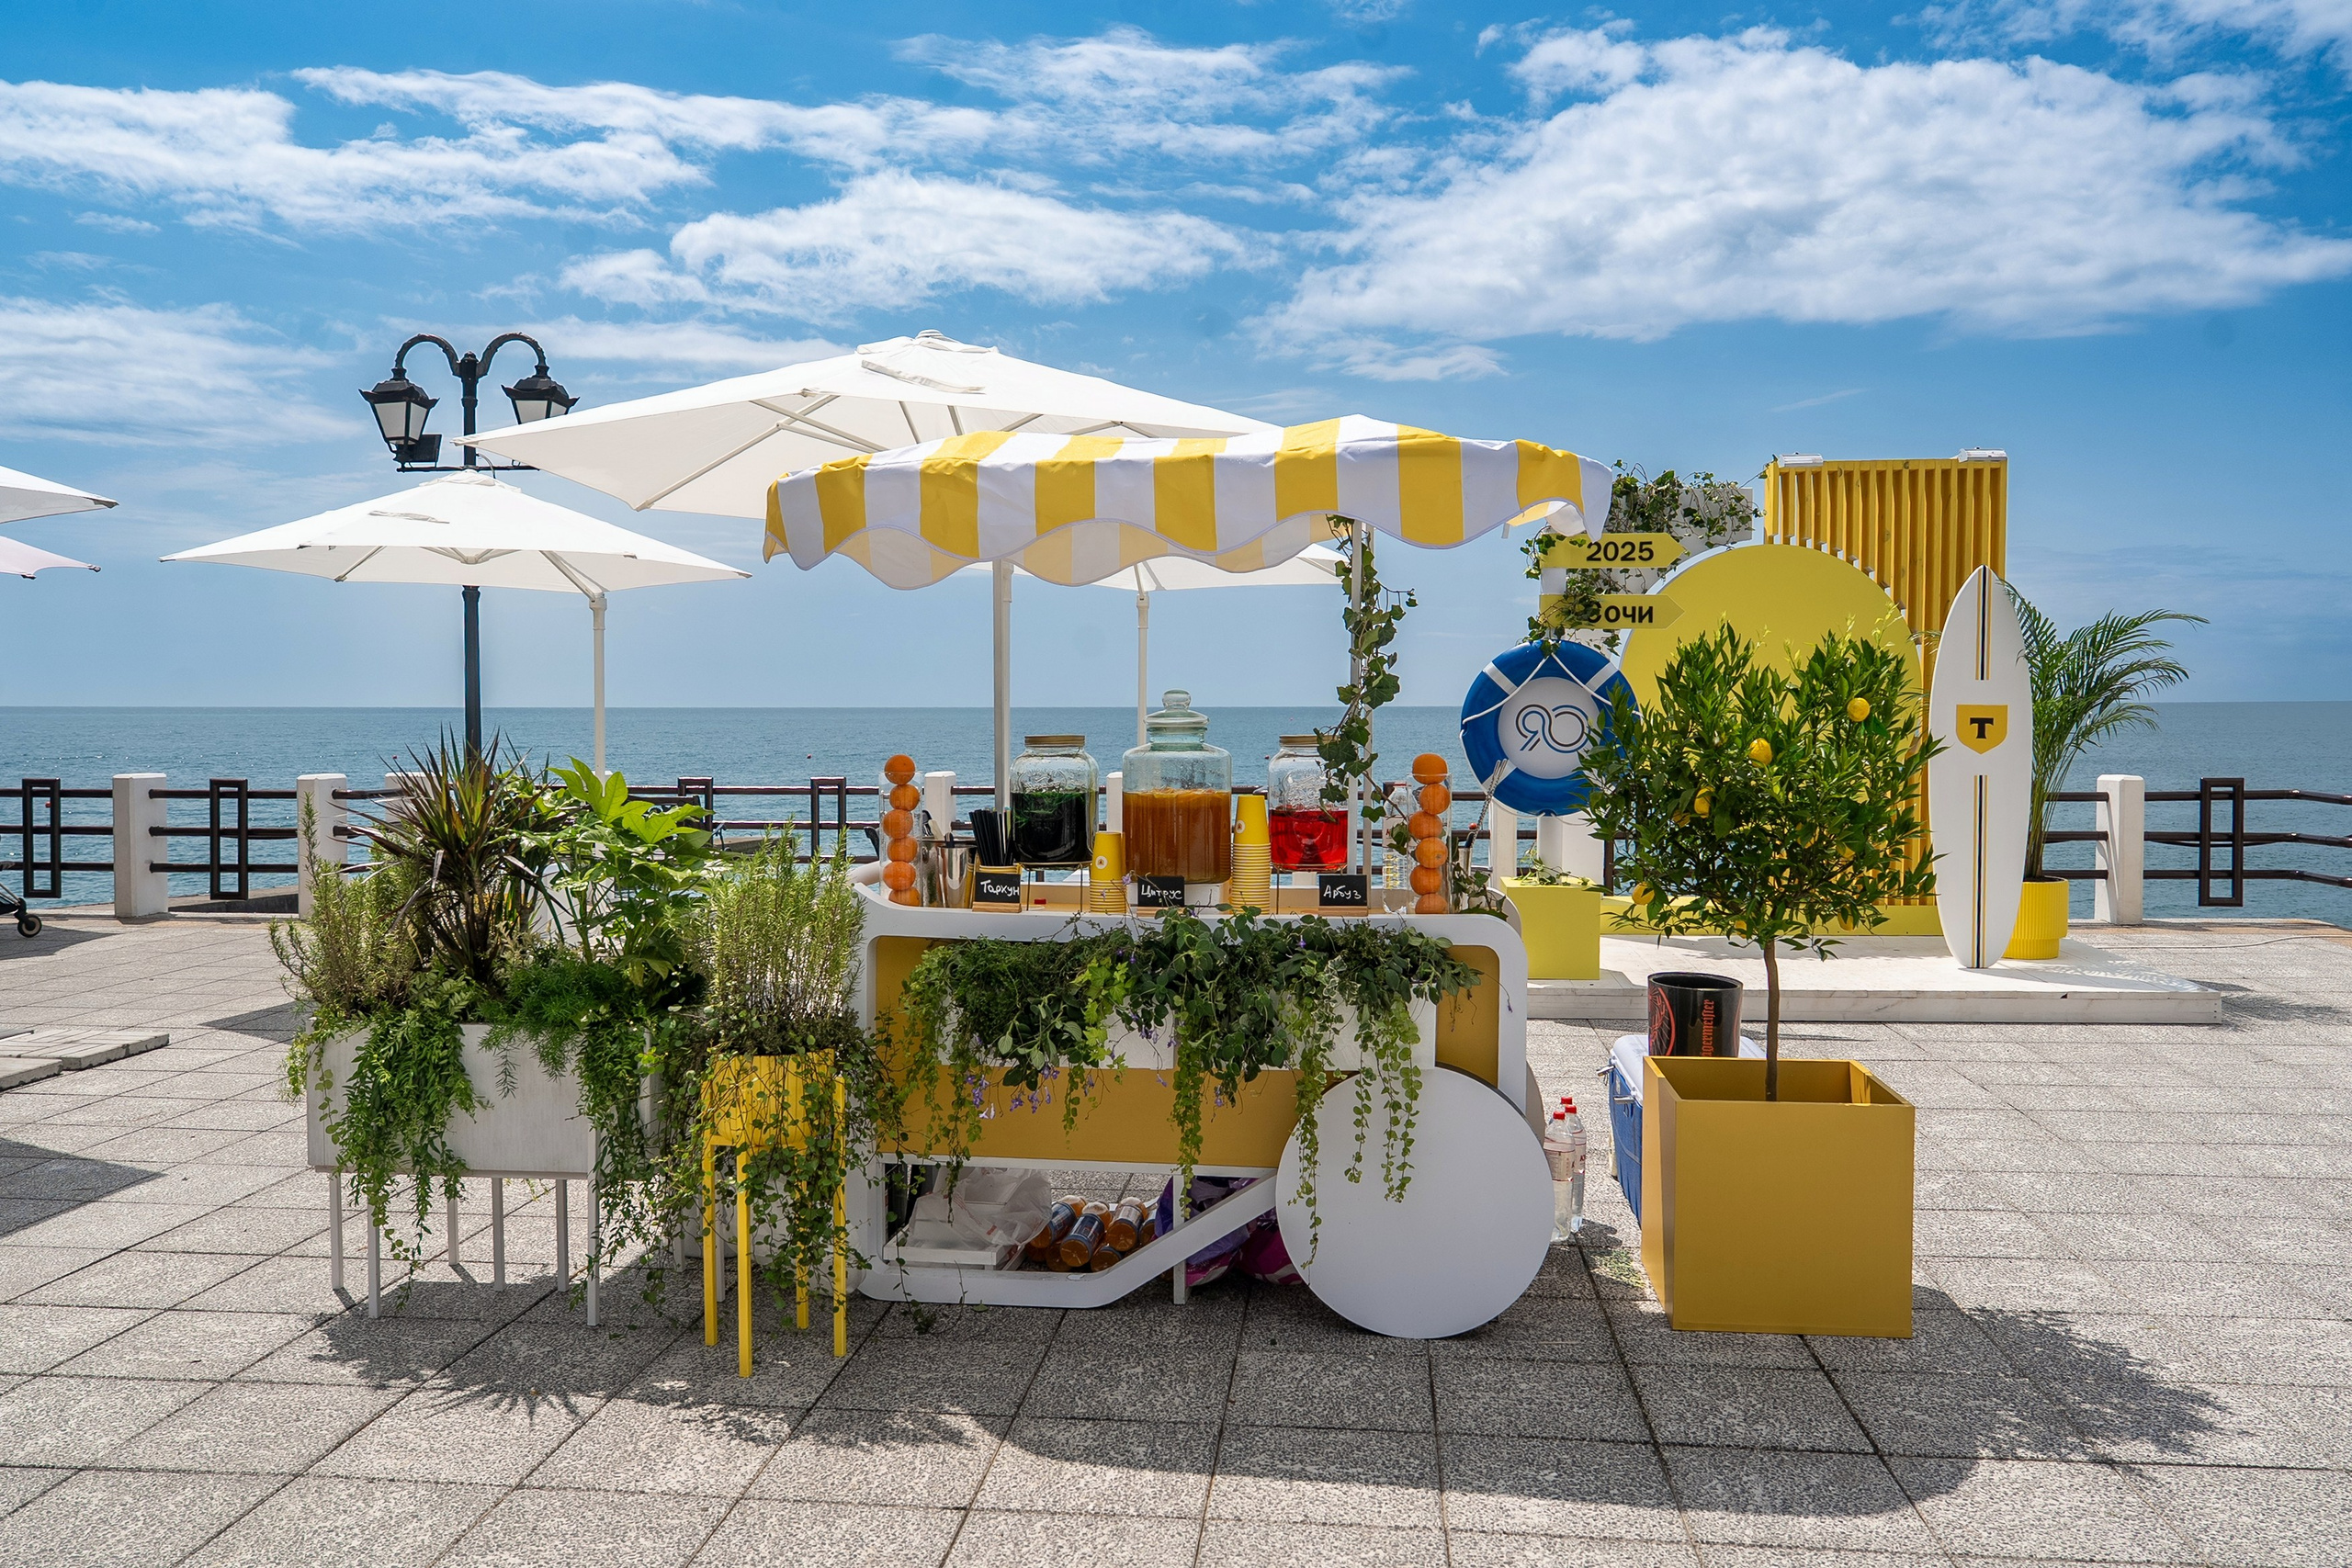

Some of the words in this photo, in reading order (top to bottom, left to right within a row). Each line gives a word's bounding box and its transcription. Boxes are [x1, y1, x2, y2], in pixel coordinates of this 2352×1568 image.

[1586, 540, 1655, 562] 2025
[1969, 716, 1995, 739] T
[979, 879, 1020, 897] Тархун
[1140, 884, 1183, 900] Цитрус
[1323, 885, 1362, 900] Арбуз
[1700, 998, 1717, 1057] ägermeister
